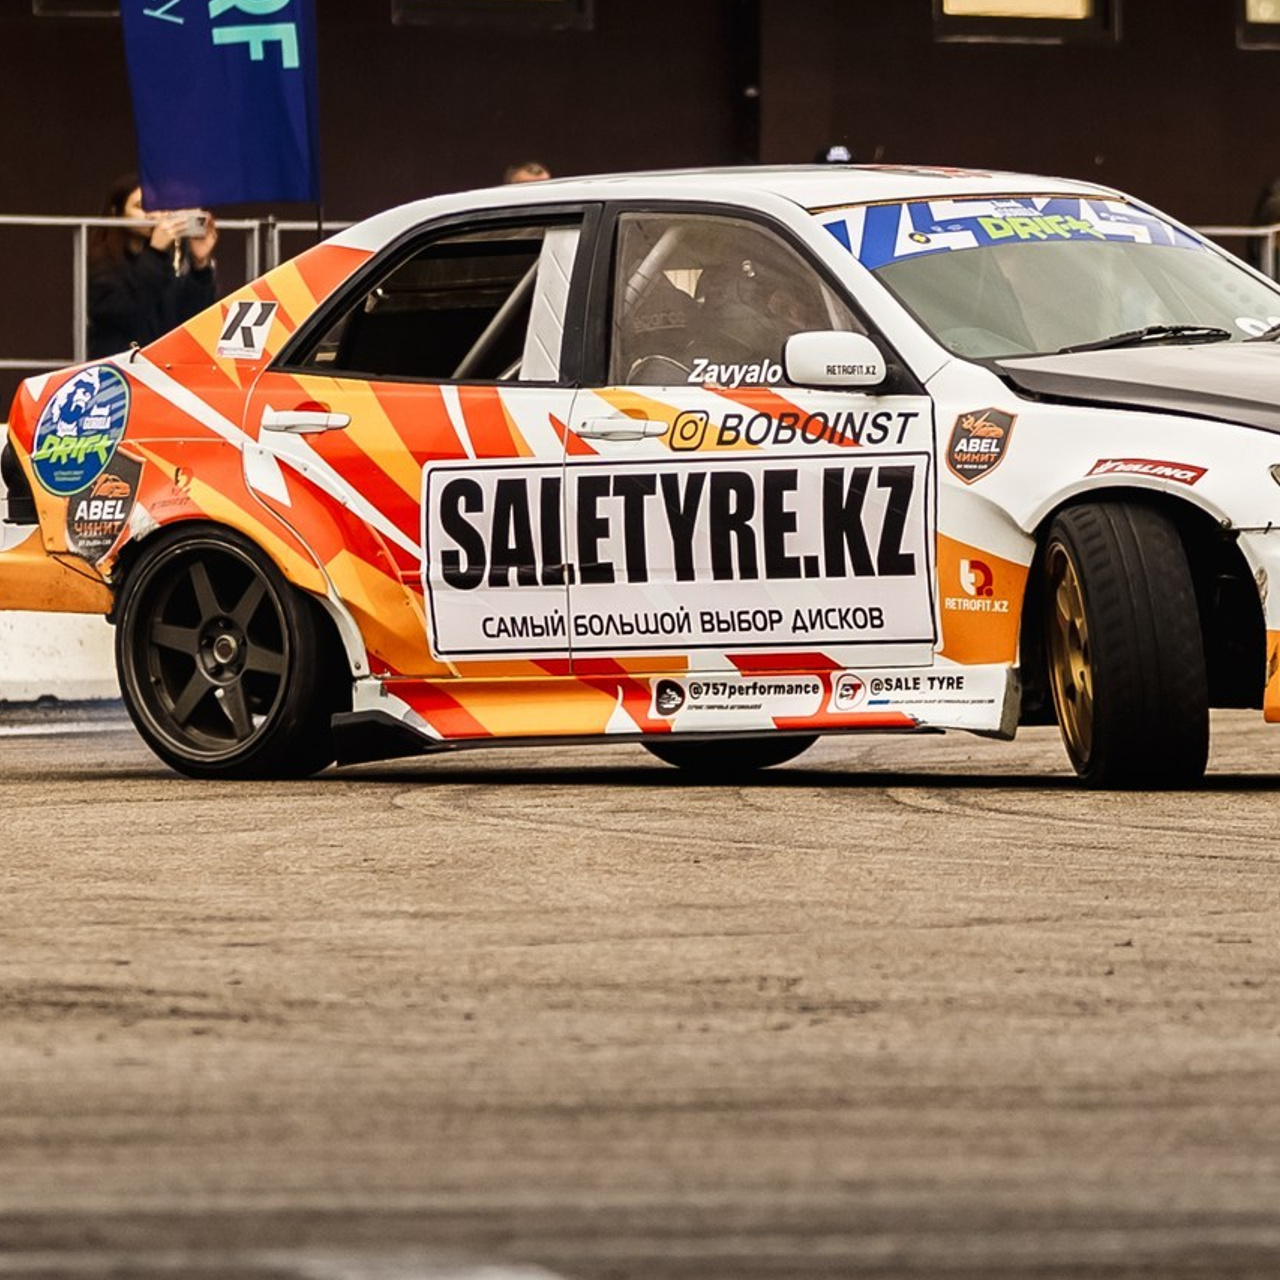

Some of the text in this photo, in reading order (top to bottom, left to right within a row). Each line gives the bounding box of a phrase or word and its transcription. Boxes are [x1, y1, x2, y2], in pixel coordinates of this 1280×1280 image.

[716, 411, 919, 446] BOBOINST
[33, 433, 115, 466] DRIFT
[954, 438, 1000, 452] ABEL
[74, 499, 126, 521] ABEL
[439, 465, 917, 590] SALETYRE.KZ
[944, 597, 1009, 613] RETROFIT.KZ
[481, 606, 885, 639] САМЫЙ БОЛЬШОЙ ВЫБОР ДИСКОВ
[688, 681, 820, 700] @757performance
